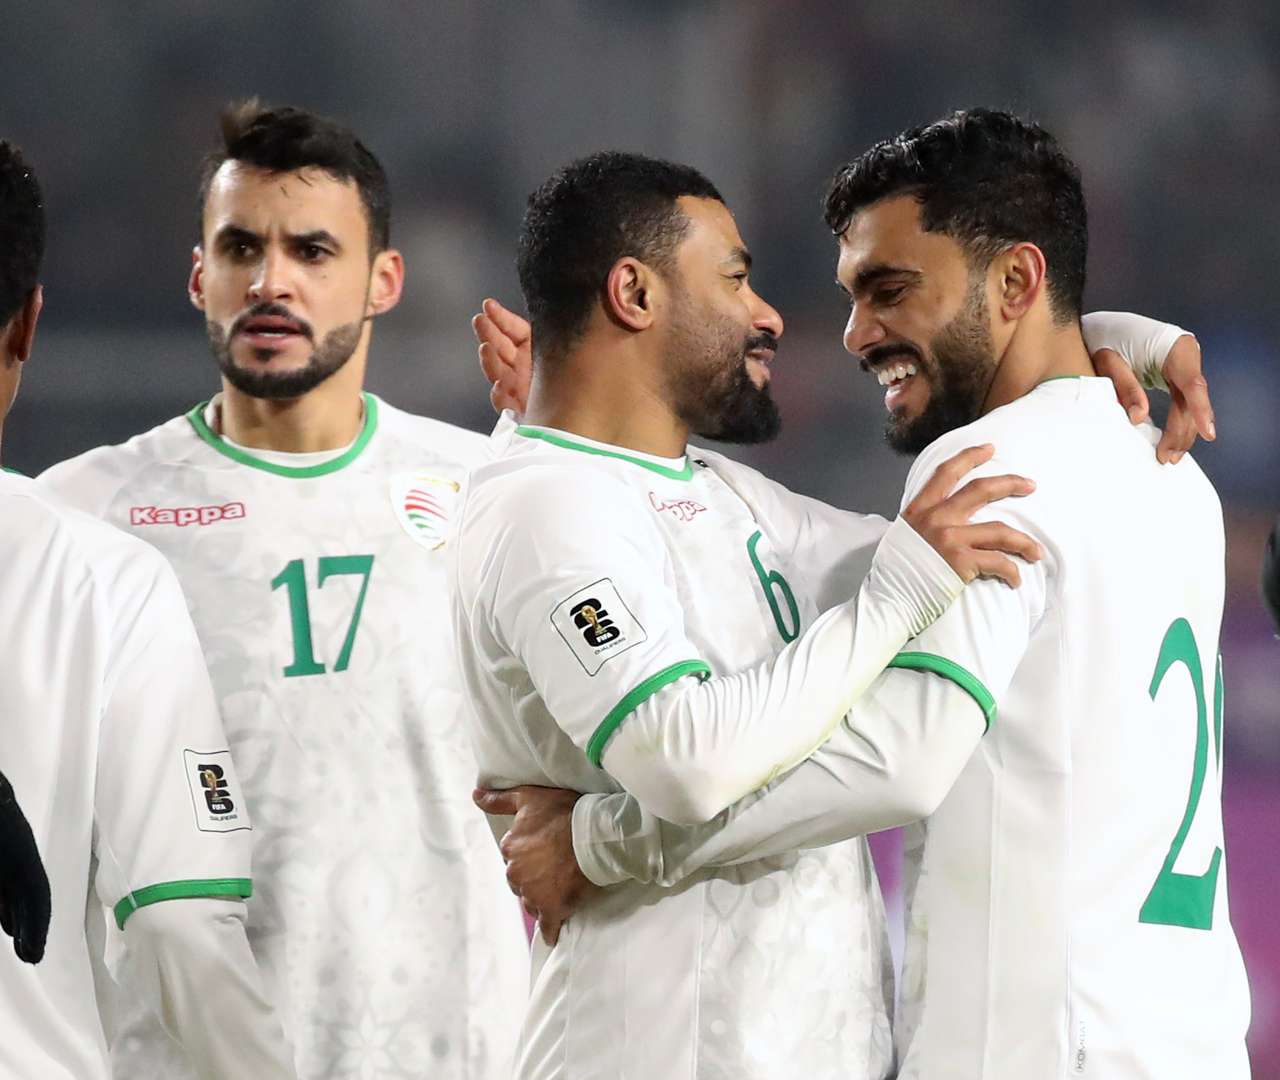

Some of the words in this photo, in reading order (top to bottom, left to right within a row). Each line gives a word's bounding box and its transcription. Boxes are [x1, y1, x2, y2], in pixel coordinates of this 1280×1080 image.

[130, 502, 245, 527] Kappa
[270, 554, 375, 678] 17
[747, 530, 801, 644] 6
[1138, 617, 1223, 931] 2
